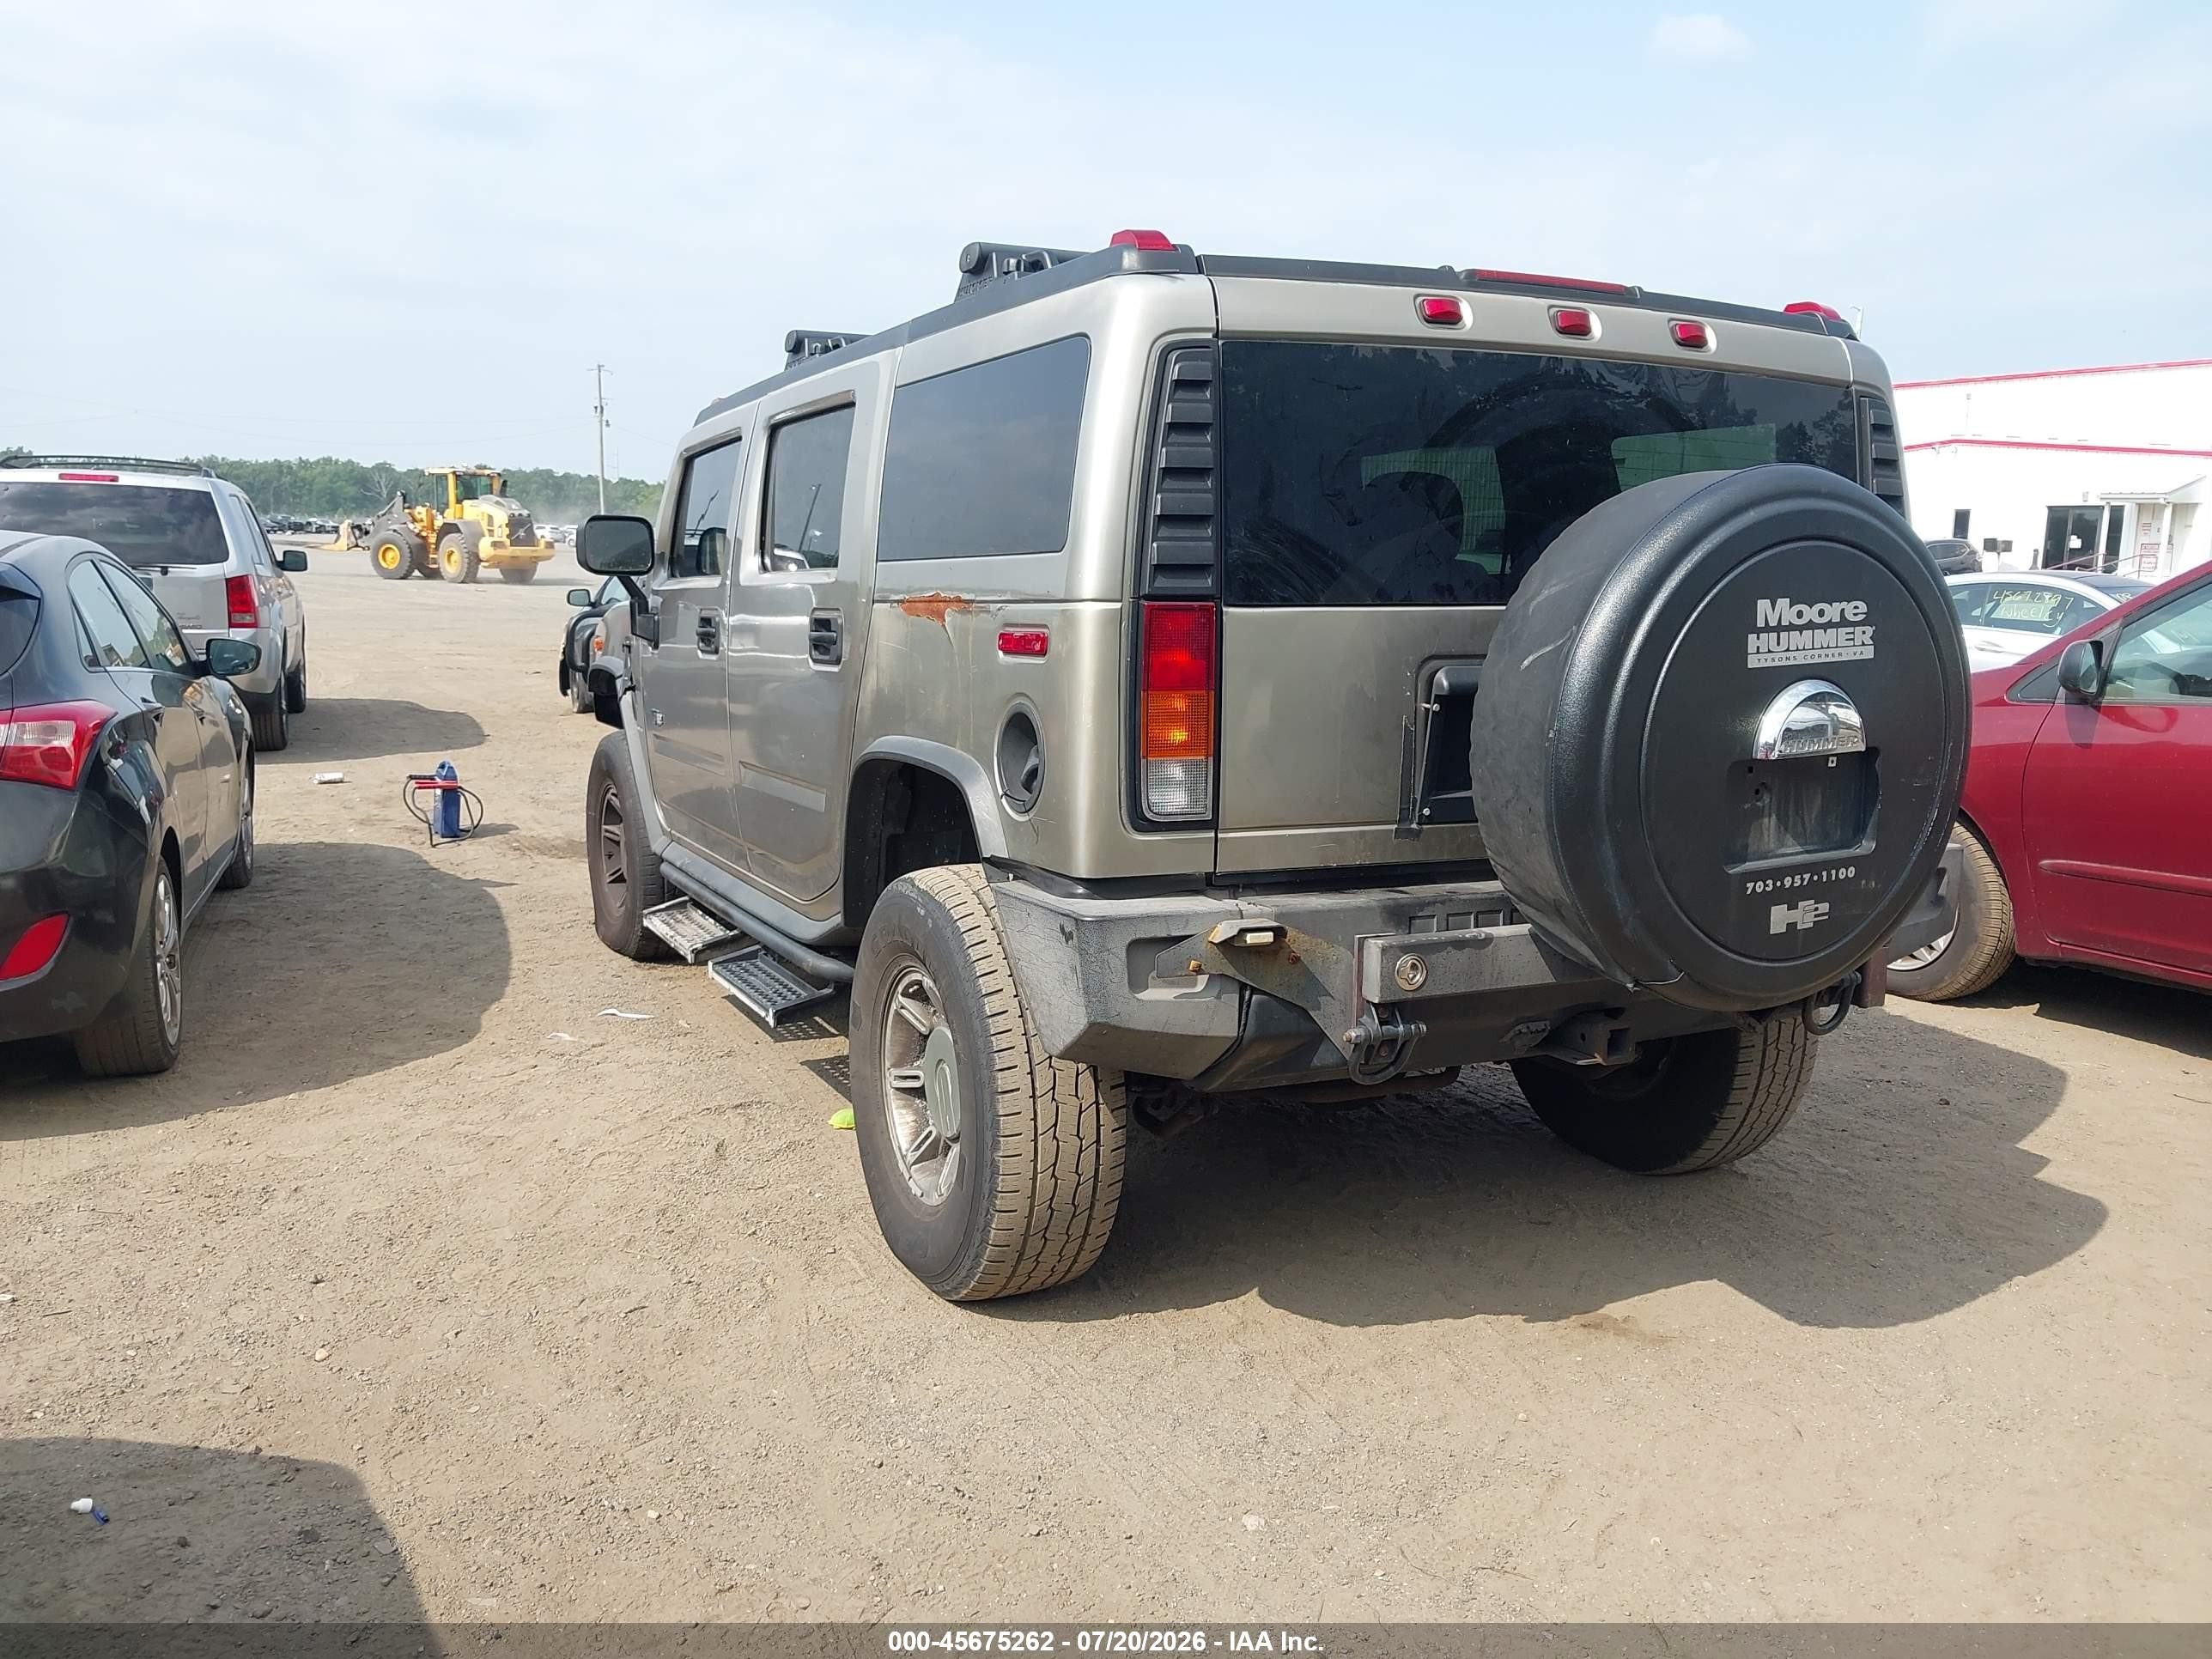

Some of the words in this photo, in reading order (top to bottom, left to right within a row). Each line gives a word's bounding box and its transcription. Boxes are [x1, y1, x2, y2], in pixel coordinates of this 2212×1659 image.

[1756, 598, 1868, 628] Moore
[1747, 625, 1875, 653] HUMMER
[1756, 655, 1798, 664] TYSONS
[1803, 651, 1843, 660] CORNER
[1780, 736, 1863, 753] HUMMER
[1770, 899, 1830, 935] H2
